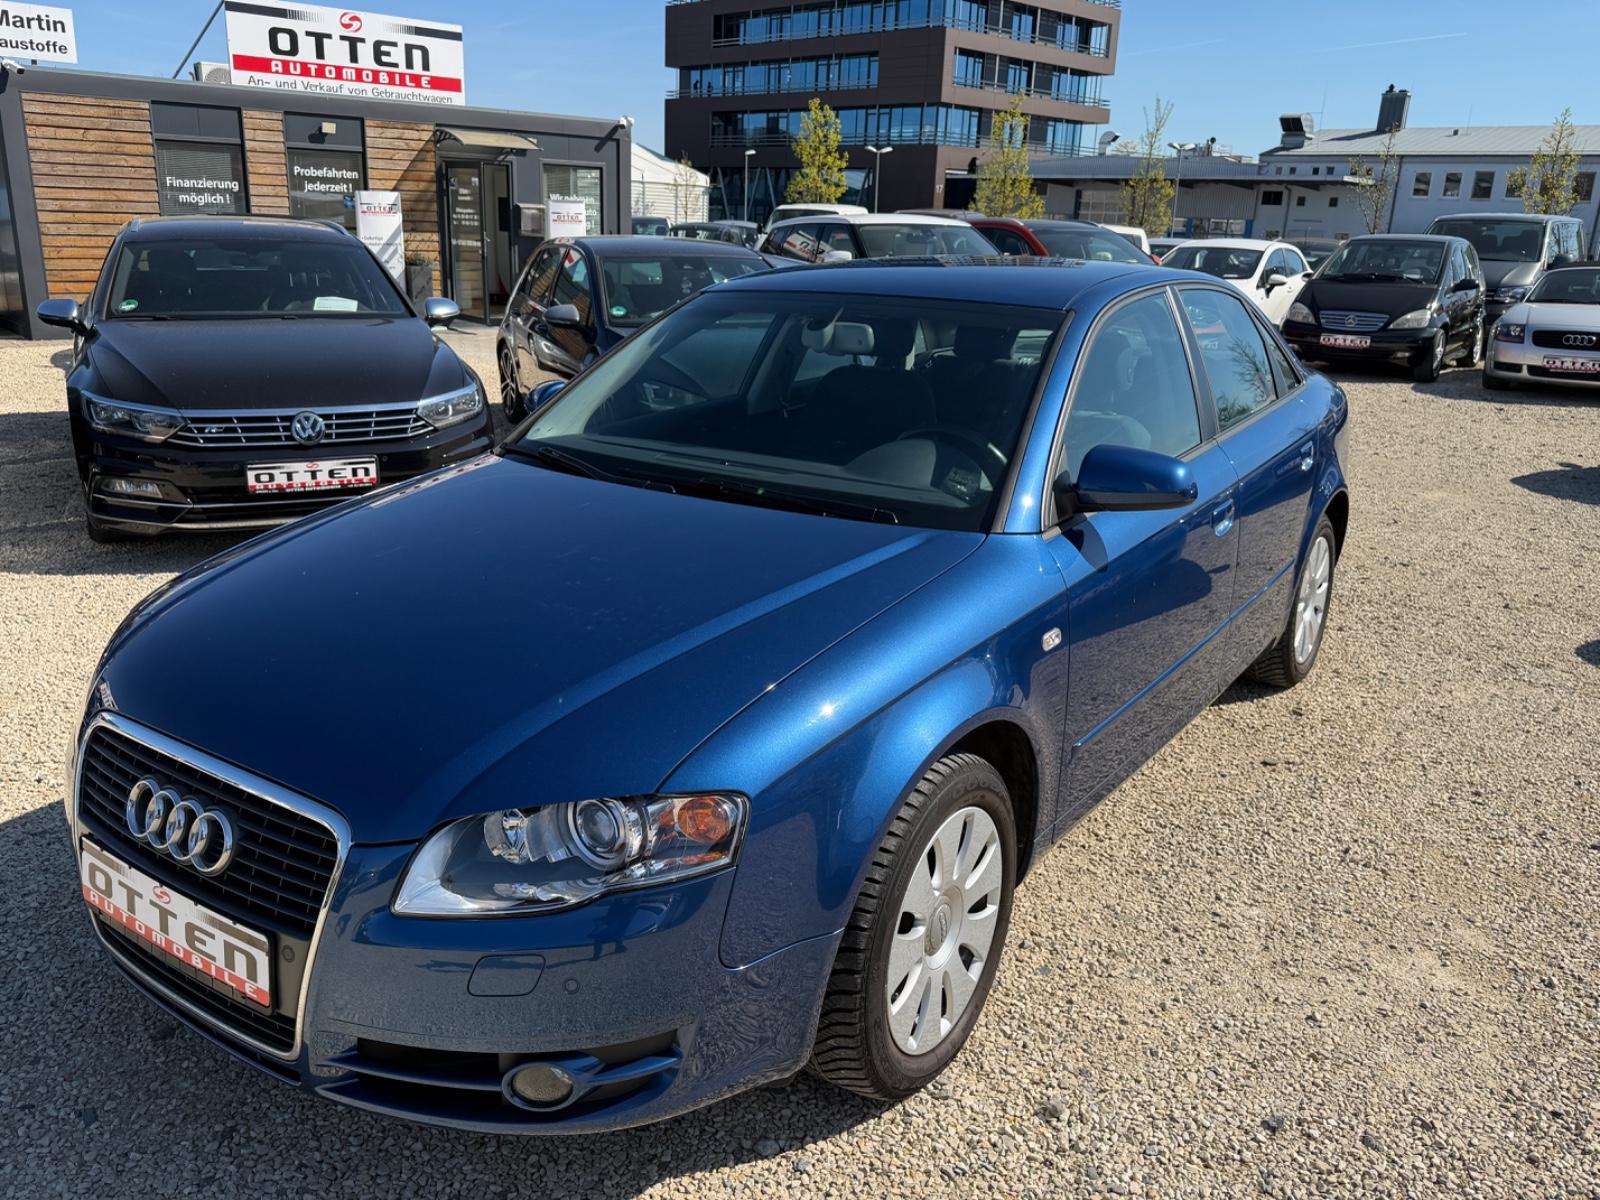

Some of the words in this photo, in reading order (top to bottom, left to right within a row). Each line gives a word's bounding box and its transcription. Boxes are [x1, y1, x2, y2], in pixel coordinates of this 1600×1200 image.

[0, 9, 66, 33] Martin
[268, 26, 430, 72] OTTEN
[271, 60, 432, 88] AUTOMOBILE
[247, 75, 271, 86] An-
[275, 79, 299, 90] und
[302, 80, 344, 94] Verkauf
[348, 86, 368, 97] von
[372, 87, 453, 104] Gebrauchtwagen
[166, 177, 239, 192] Finanzierung
[294, 166, 359, 179] Probefahrten
[304, 181, 347, 193] jederzeit
[179, 193, 224, 206] möglich
[254, 466, 370, 484] OTTEN
[88, 862, 258, 983] OTTEN
[90, 894, 258, 999] AUTOMOBILE
